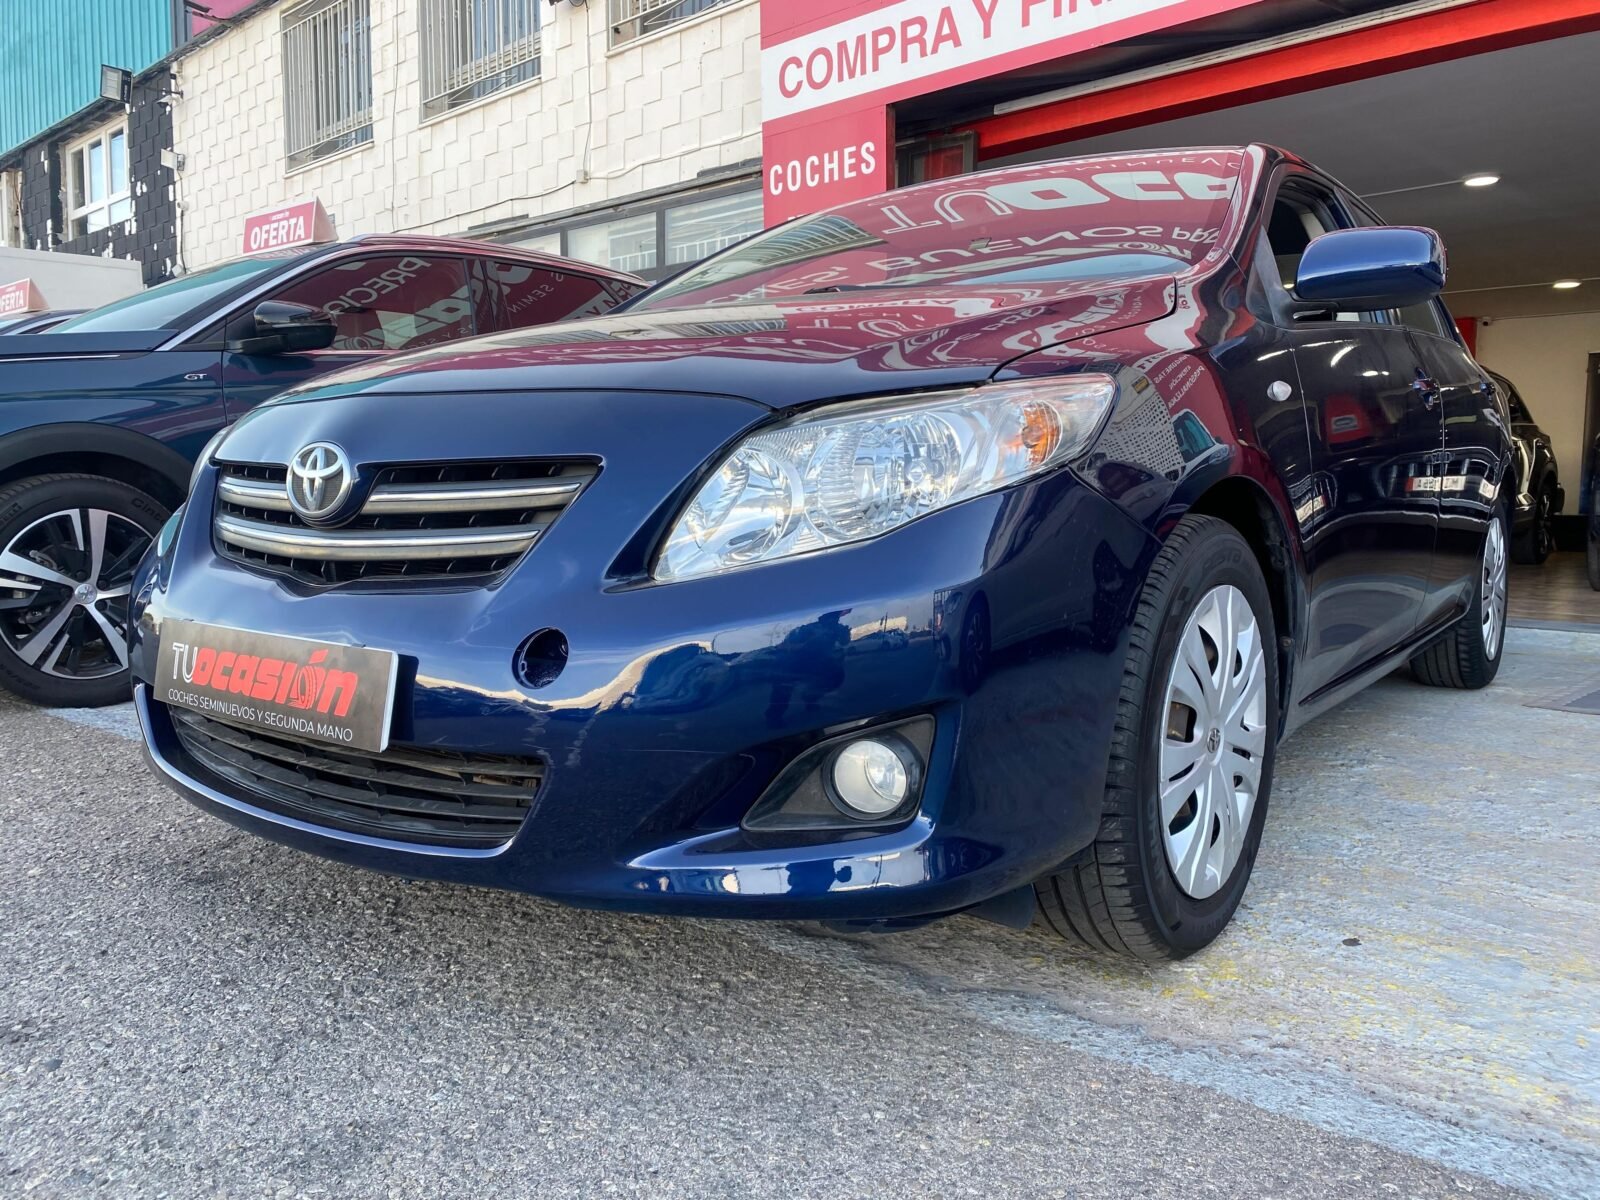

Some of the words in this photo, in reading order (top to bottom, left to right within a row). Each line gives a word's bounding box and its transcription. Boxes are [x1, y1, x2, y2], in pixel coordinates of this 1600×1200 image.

[778, 7, 962, 99] COMPRA
[972, 0, 998, 39] Y
[769, 141, 876, 196] COCHES
[250, 216, 305, 250] OFERTA
[168, 688, 199, 706] COCHES
[199, 696, 255, 721] SEMINUEVOS
[257, 709, 264, 722] Y
[264, 711, 314, 734] SEGUNDA
[317, 723, 353, 742] MANO
